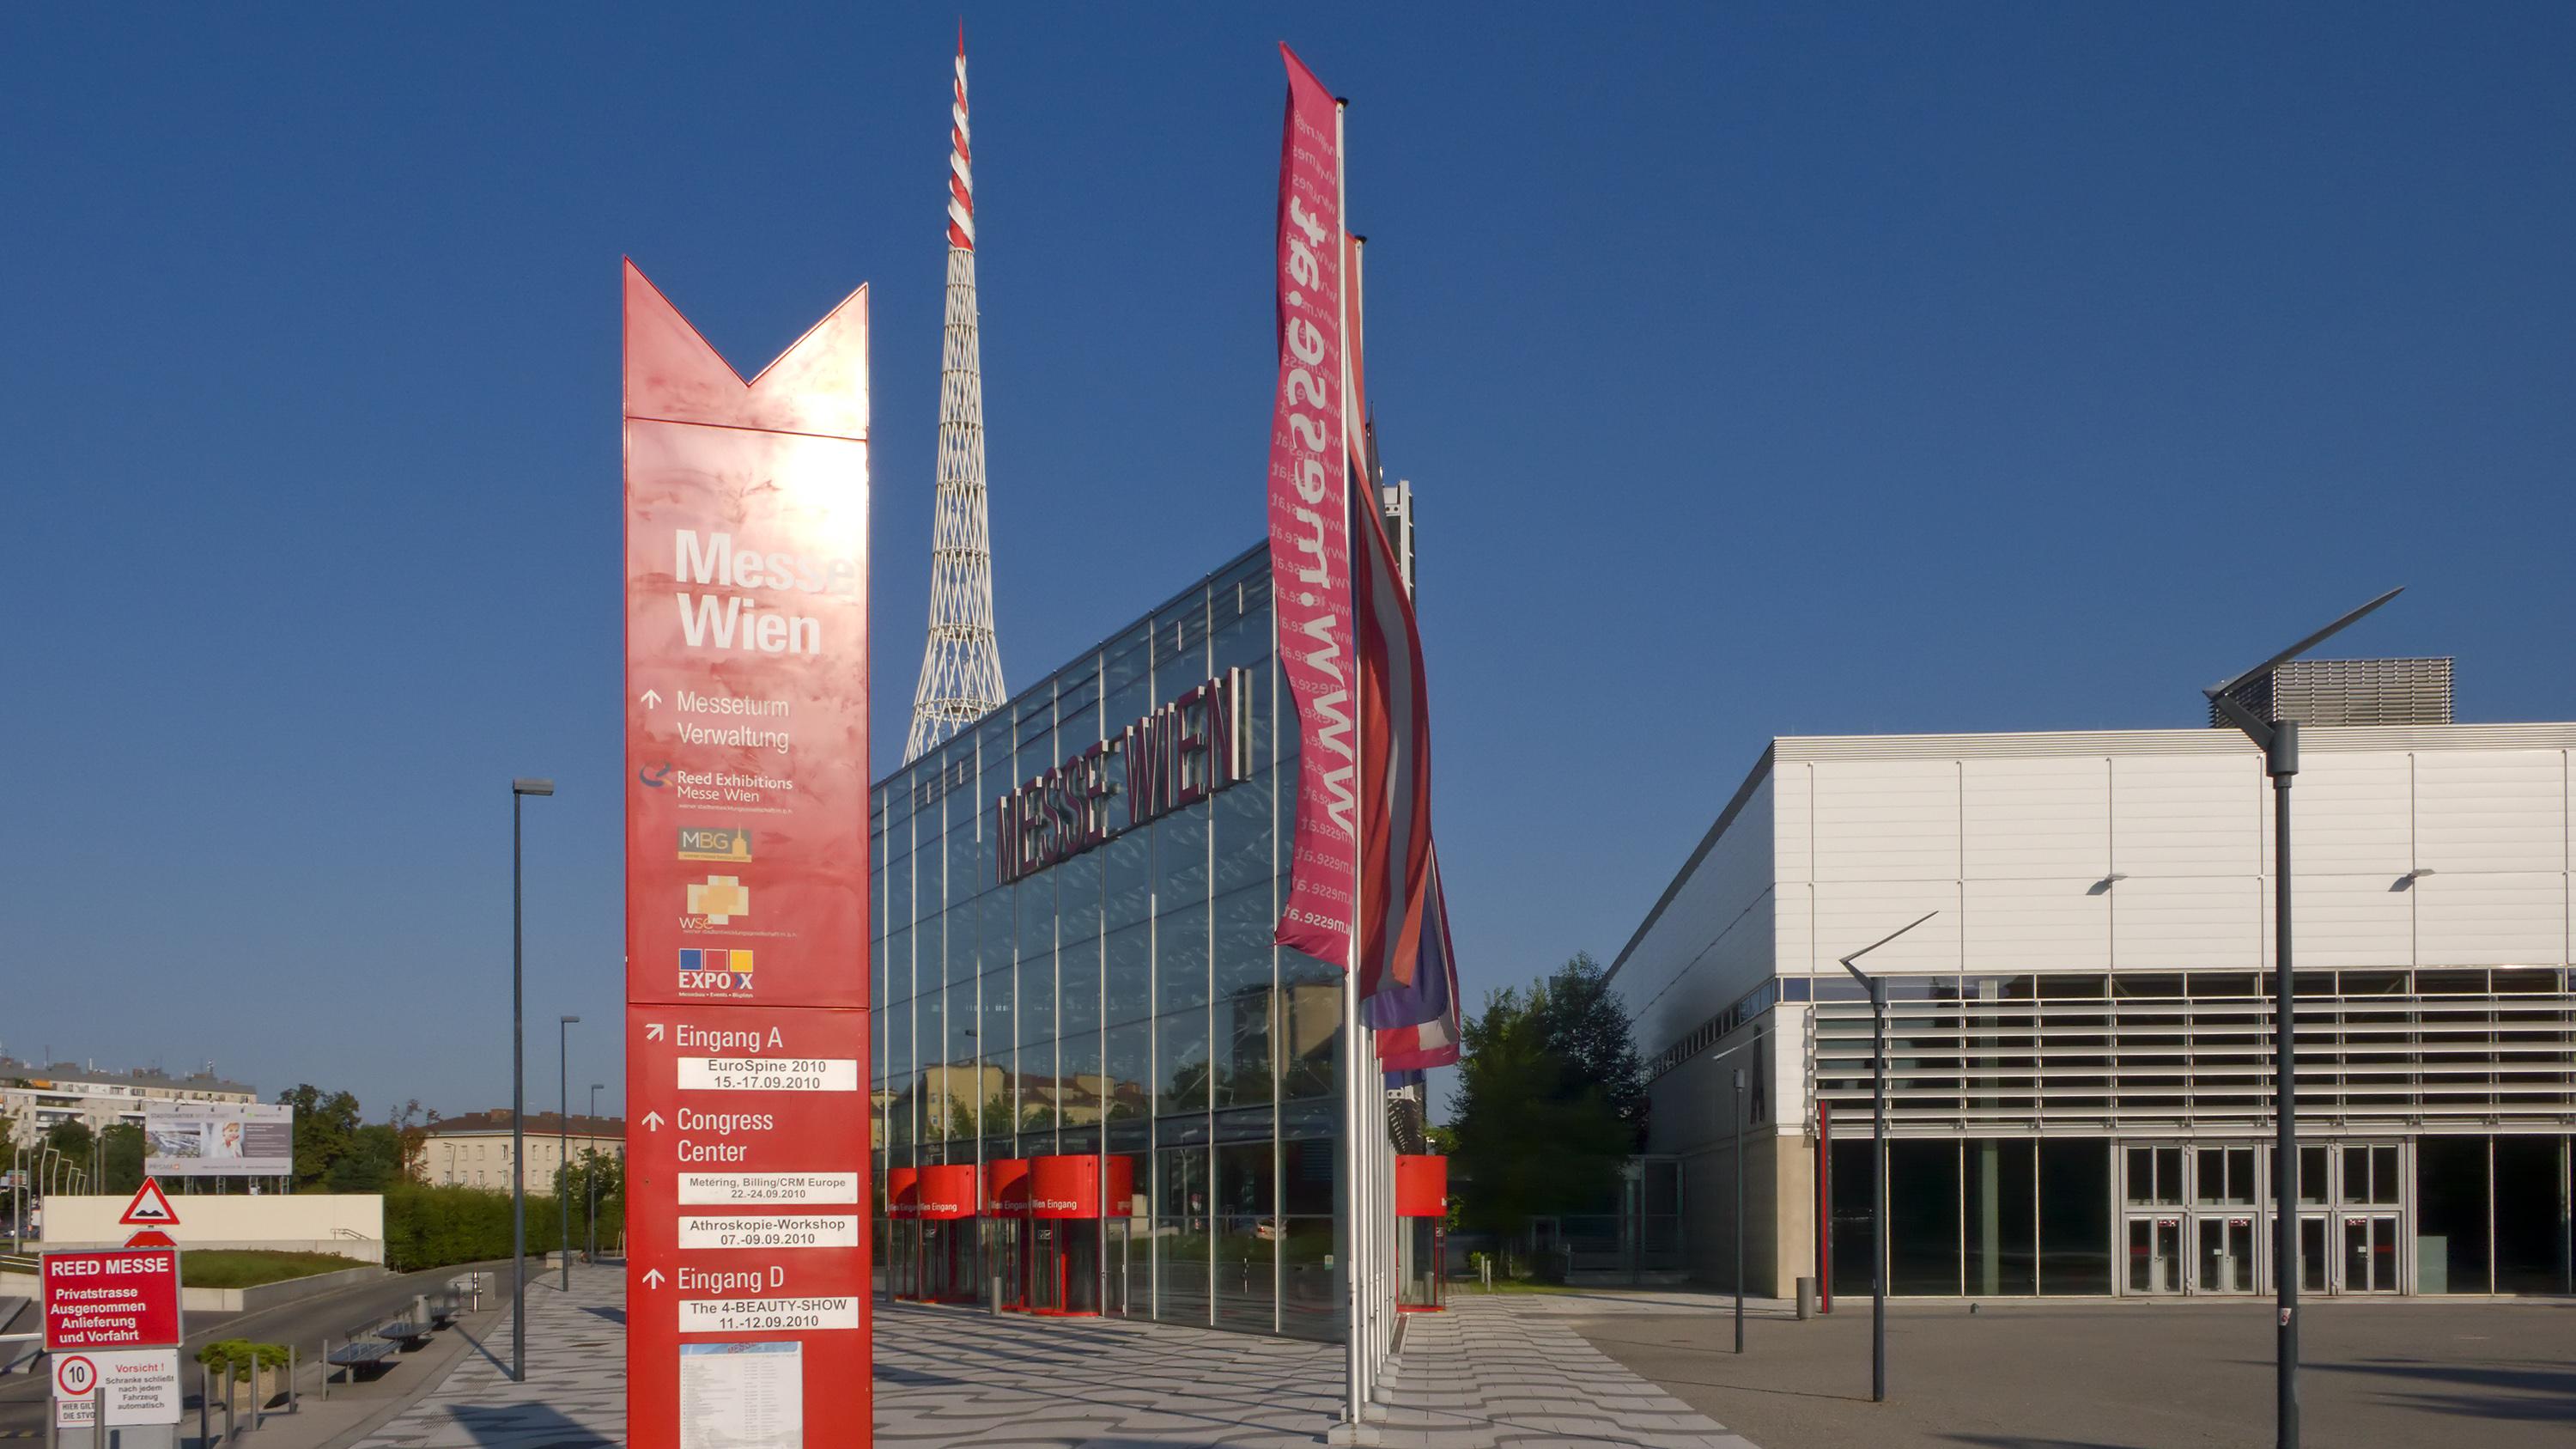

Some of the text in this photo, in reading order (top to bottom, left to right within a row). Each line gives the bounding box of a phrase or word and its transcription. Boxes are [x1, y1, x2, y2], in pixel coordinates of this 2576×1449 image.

[676, 529, 854, 594] Messe
[677, 593, 821, 654] Wien
[677, 691, 789, 716] Messeturm
[677, 722, 789, 753] Verwaltung
[677, 770, 793, 790] Reed Exhibitions
[996, 667, 1239, 885] MESSE WIEN
[677, 786, 759, 802] Messe Wien
[683, 831, 728, 849] MBG
[678, 971, 731, 989] EXPO
[677, 1025, 783, 1053] Eingang A
[708, 1059, 827, 1074] EuroSpine 2010
[714, 1076, 821, 1089] 15.-17.09.2010
[677, 1107, 774, 1135] Congress
[677, 1139, 747, 1162] Center
[690, 1178, 846, 1188] Metering, Billing/CRM Europe
[731, 1189, 806, 1198] 22.-24.09.2010
[932, 1202, 957, 1212] Eingang
[1047, 1199, 1077, 1210] Eingang
[690, 1219, 846, 1231] Athroskopie-Workshop
[720, 1233, 816, 1245] 07.-09.09.2010
[52, 1257, 169, 1276] REED MESSE
[678, 1266, 784, 1294] Eingang D
[56, 1288, 137, 1300] Privatstrasse
[51, 1302, 146, 1316] Ausgenommen
[690, 1299, 847, 1314] The 4-BEAUTY-SHOW
[61, 1317, 137, 1329] Anlieferung
[720, 1315, 818, 1329] 11.-12.09.2010
[59, 1330, 139, 1342] und Vorfahrt
[69, 1366, 84, 1383] 10
[115, 1363, 158, 1373] Vorsicht
